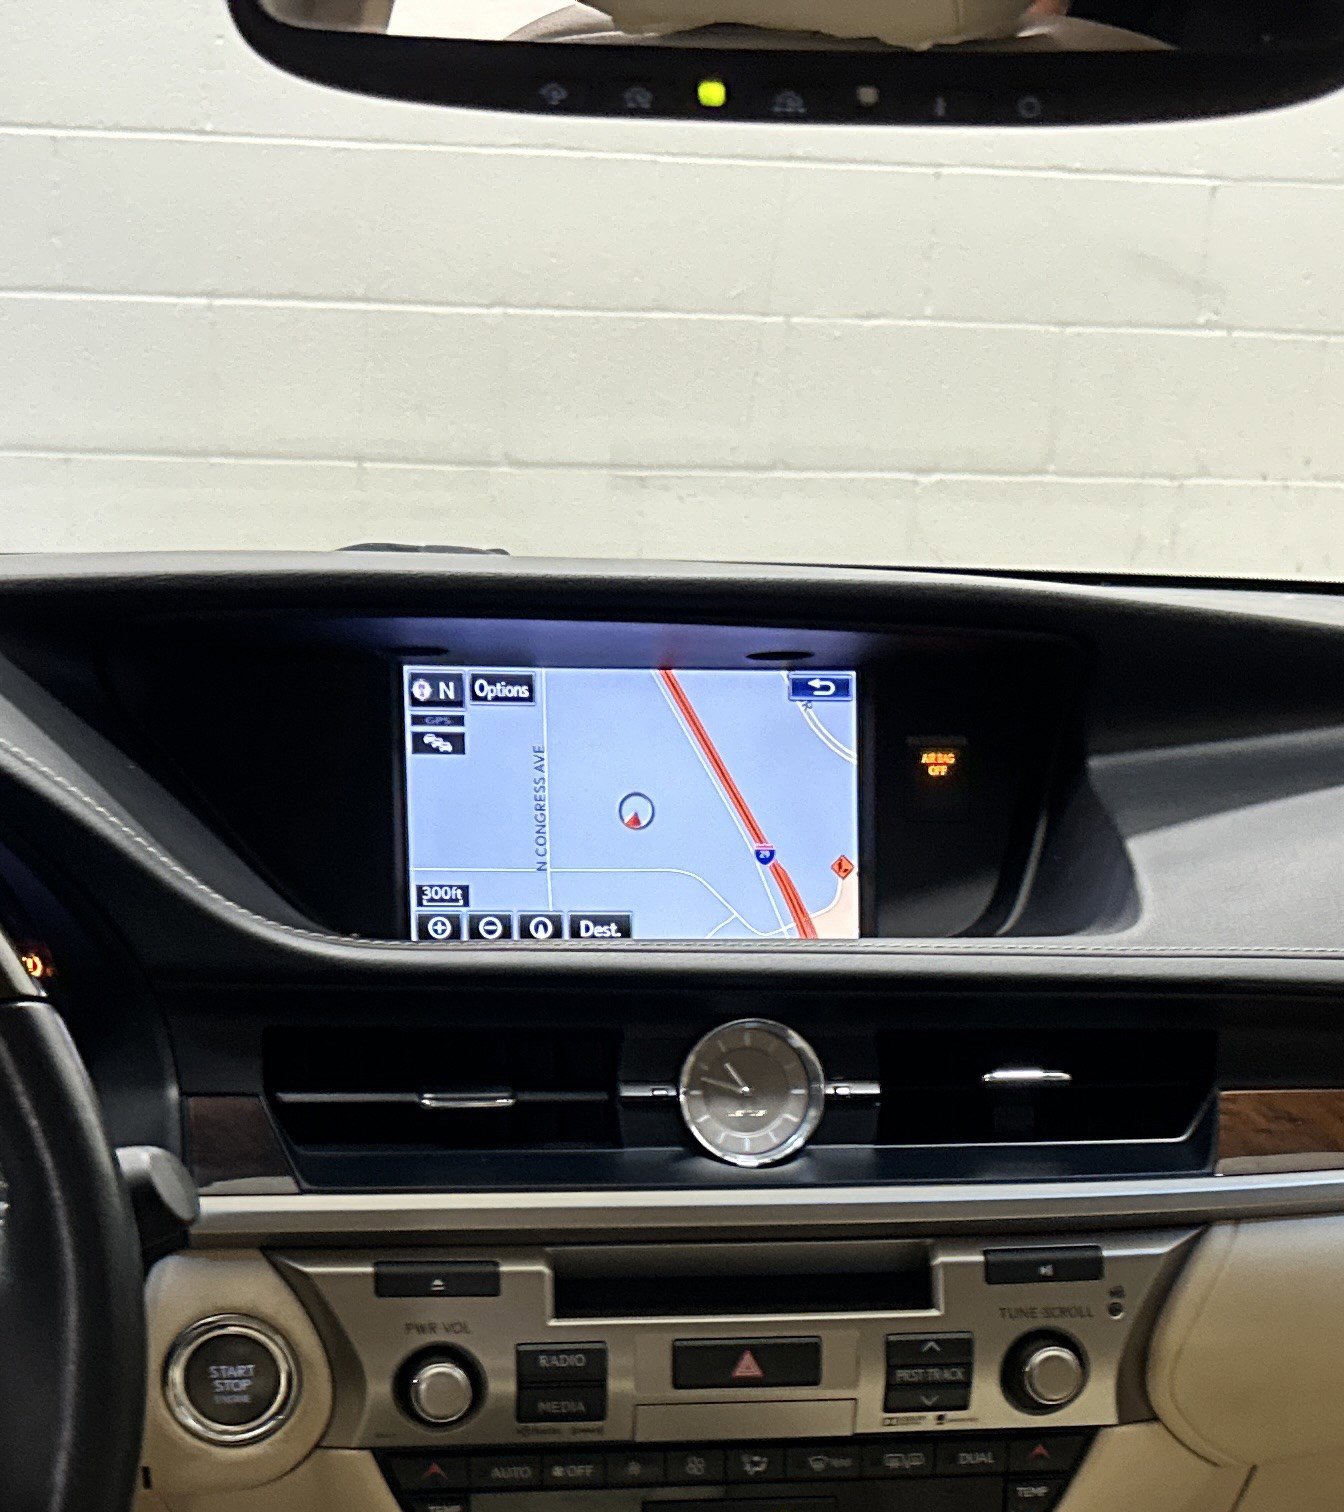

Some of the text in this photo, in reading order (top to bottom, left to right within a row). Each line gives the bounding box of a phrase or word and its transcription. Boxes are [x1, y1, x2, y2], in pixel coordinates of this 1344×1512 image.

[439, 682, 455, 700] N
[474, 679, 531, 701] Options
[532, 745, 548, 872] N CONGRESS AVE
[422, 886, 464, 900] 300ft
[579, 919, 622, 938] Dest.
[998, 1305, 1096, 1319] TUNE SCROLL
[404, 1321, 471, 1335] PWR VOL
[538, 1353, 587, 1368] RADIO
[208, 1364, 255, 1379] START
[213, 1379, 253, 1393] STOP
[537, 1400, 587, 1414] MEDIA
[490, 1465, 532, 1479] AUTO
[567, 1464, 595, 1478] OFF
